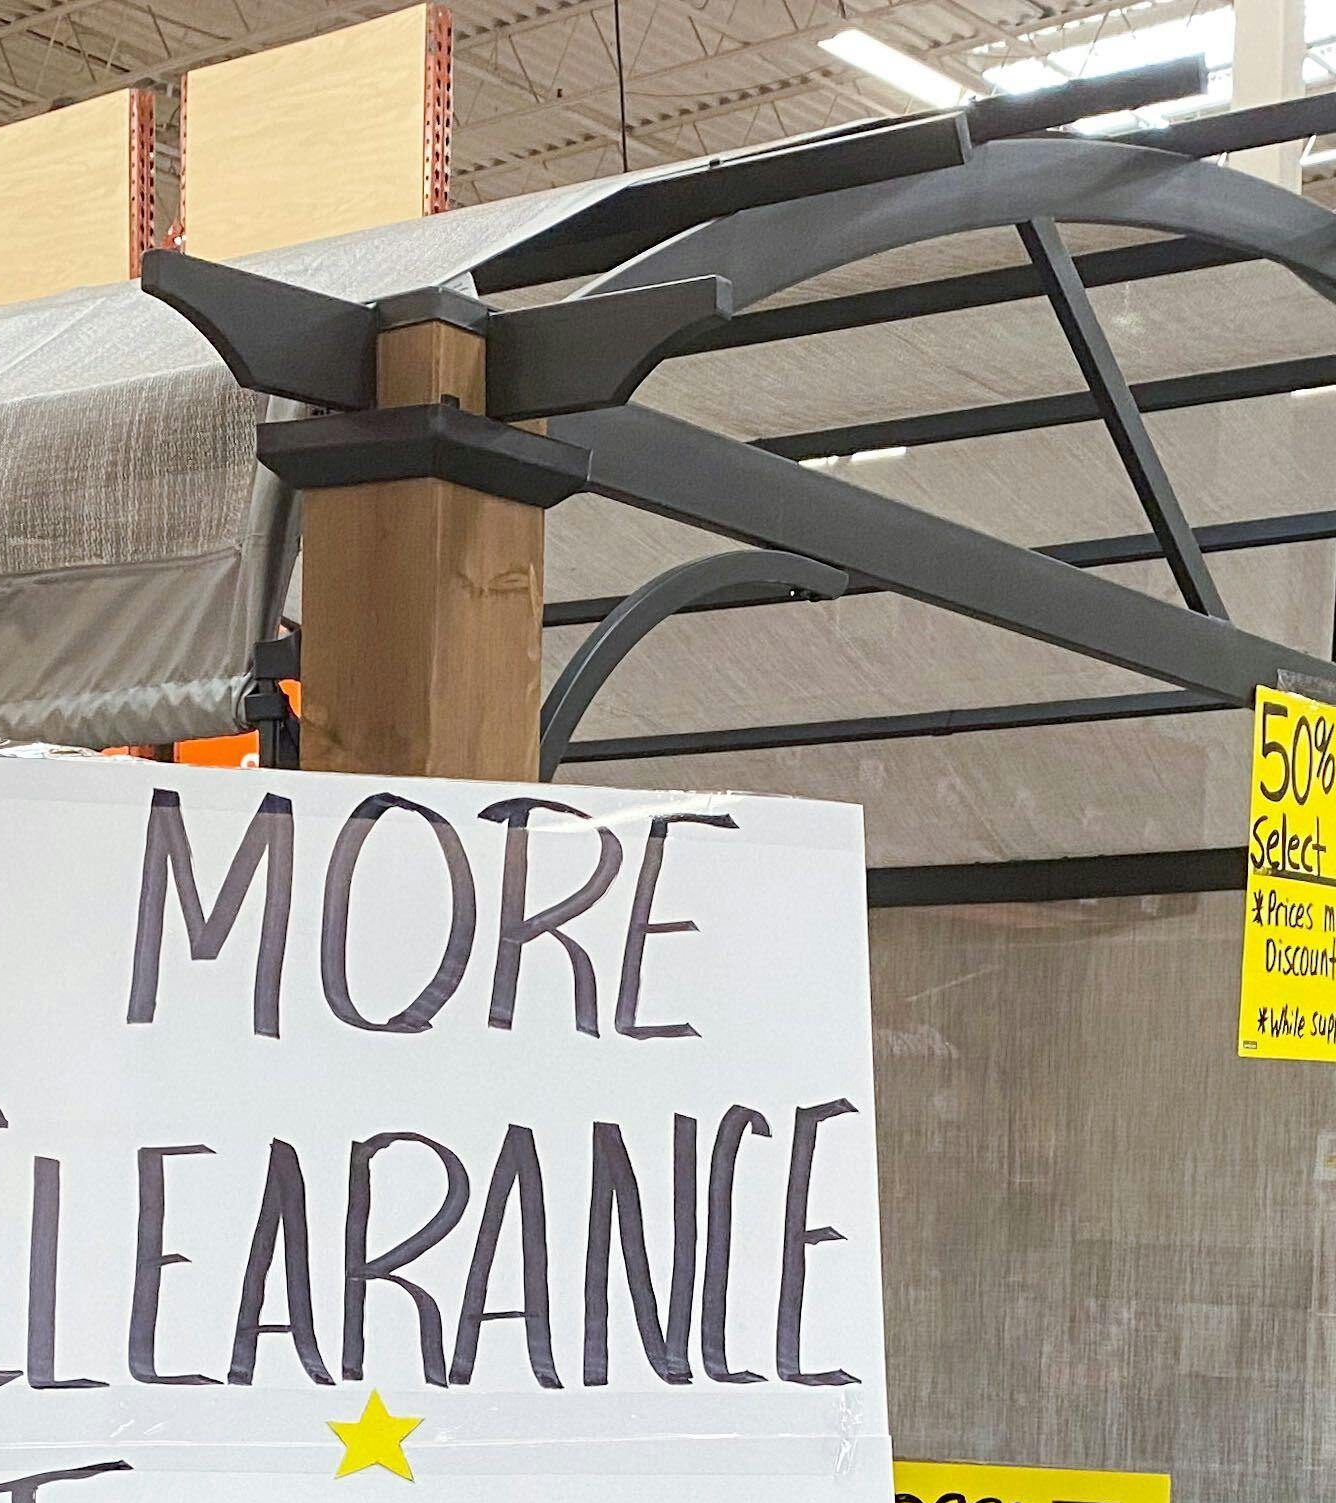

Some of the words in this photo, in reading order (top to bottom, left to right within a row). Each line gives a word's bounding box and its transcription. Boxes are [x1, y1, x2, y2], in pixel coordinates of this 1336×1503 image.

[1259, 702, 1336, 805] 50%
[1250, 813, 1326, 874] Select
[127, 789, 739, 1039] MORE
